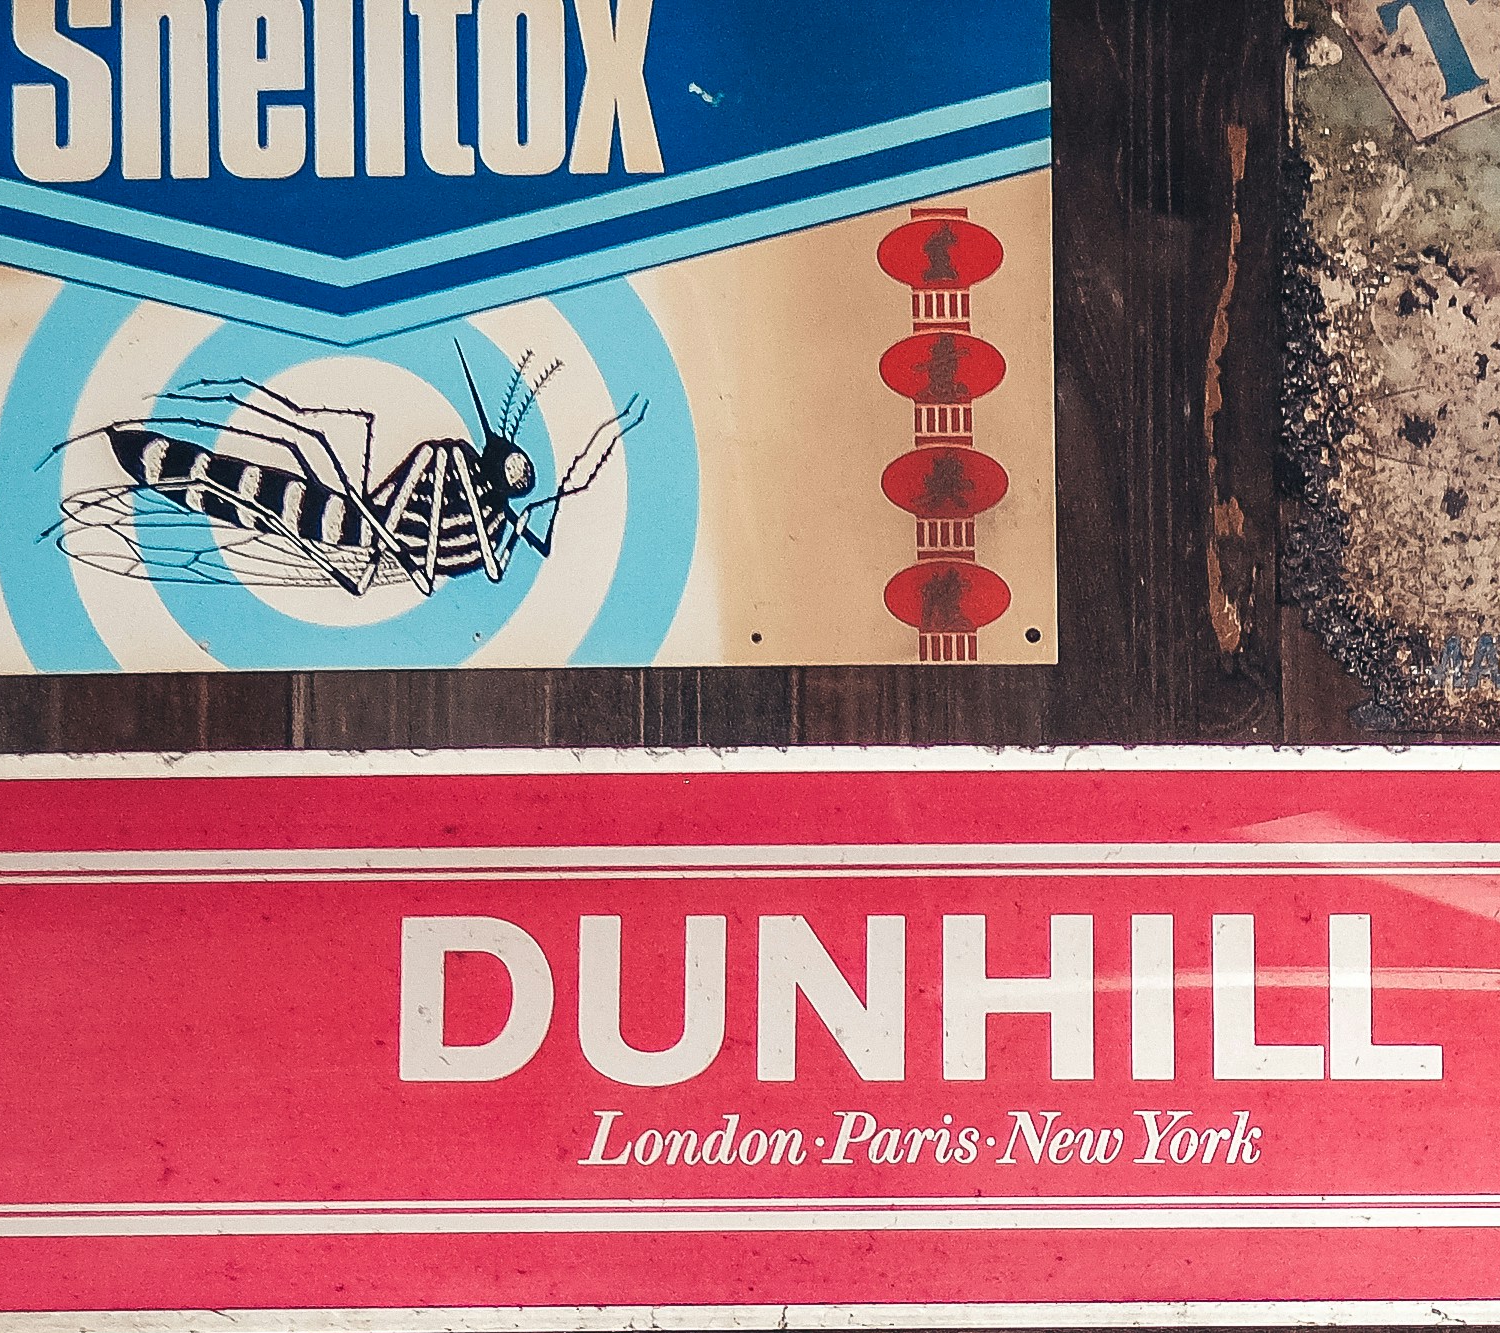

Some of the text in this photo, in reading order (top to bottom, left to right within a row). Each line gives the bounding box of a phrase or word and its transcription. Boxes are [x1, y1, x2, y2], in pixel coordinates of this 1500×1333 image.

[399, 913, 1444, 1088] DUNHILL
[995, 1109, 1124, 1165] New
[1132, 1109, 1264, 1165] York
